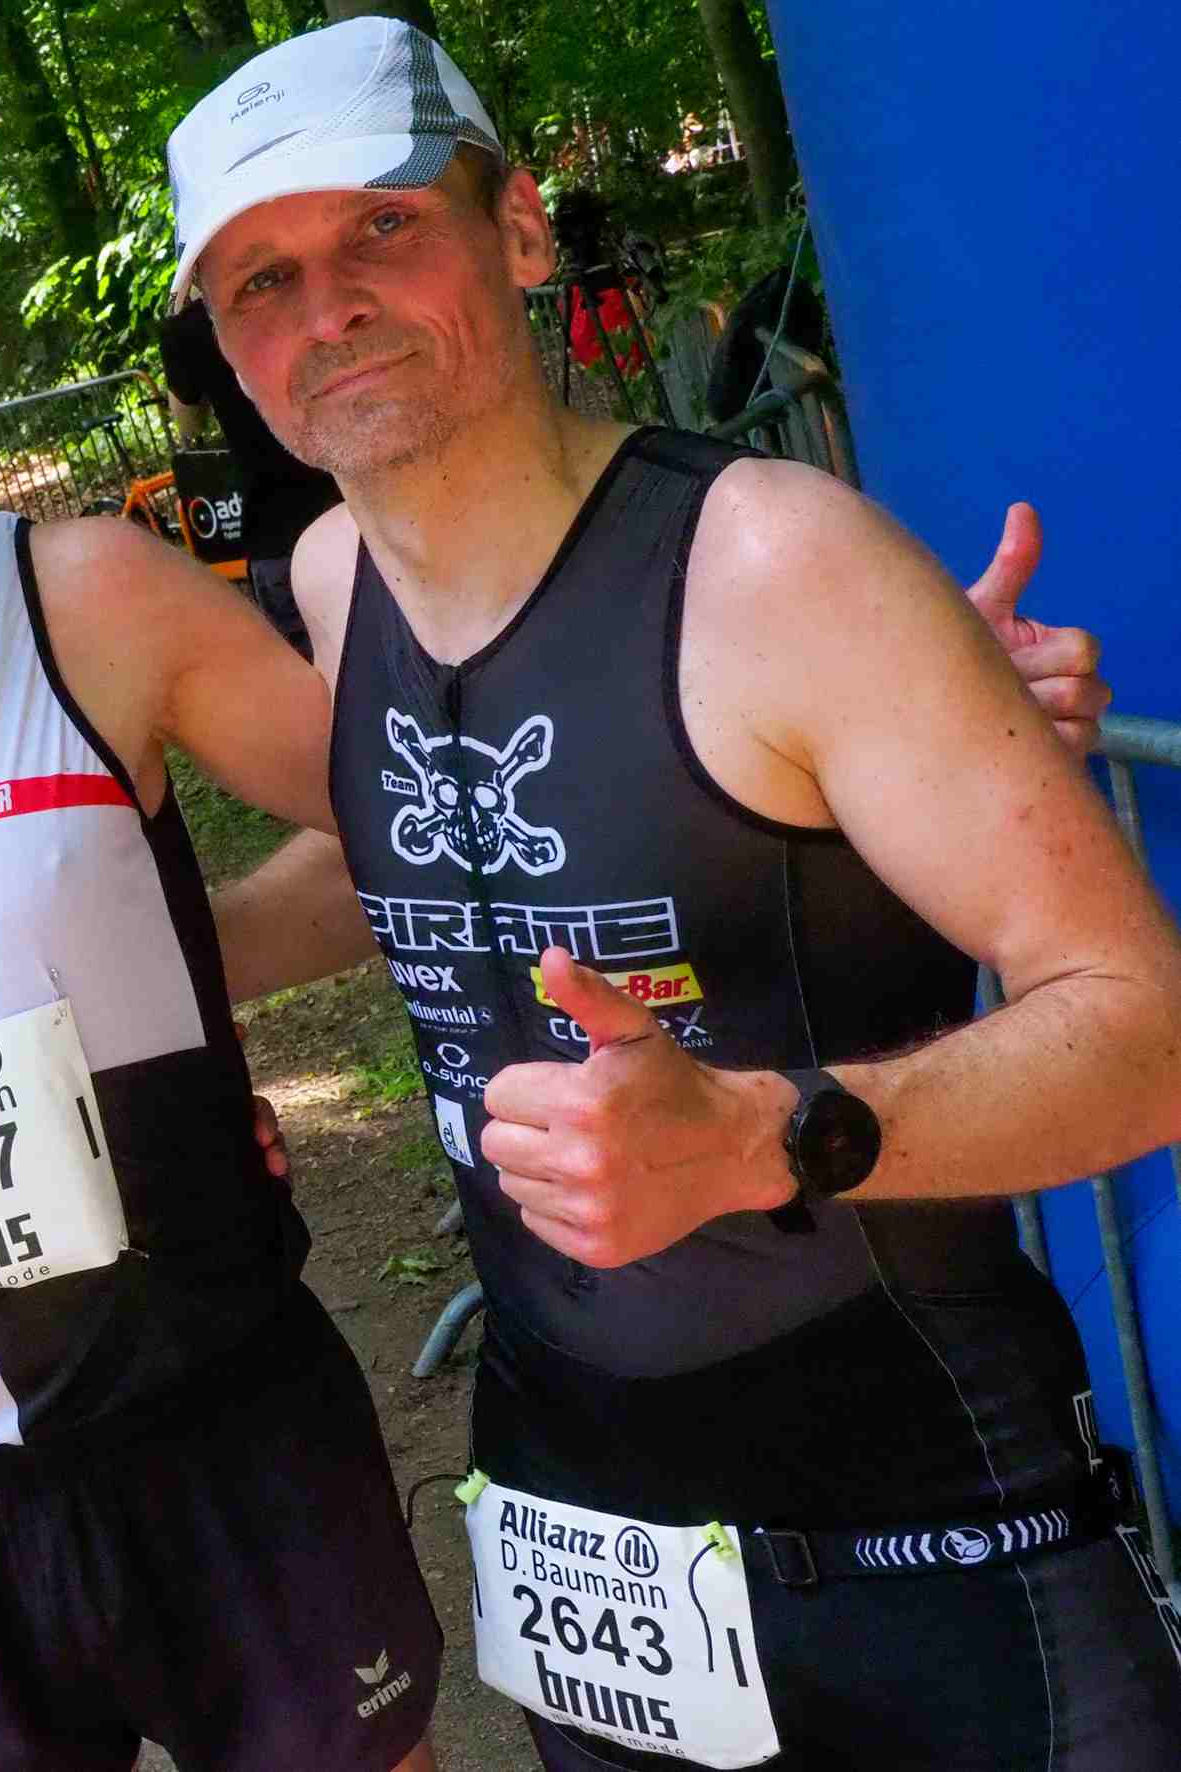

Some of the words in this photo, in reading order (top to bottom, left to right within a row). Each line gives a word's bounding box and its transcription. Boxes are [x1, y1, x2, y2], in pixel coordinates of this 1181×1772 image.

[383, 772, 417, 793] Team
[357, 889, 680, 960] PIRATE
[387, 957, 464, 992] uvex
[422, 1060, 488, 1089] o_sync
[499, 1500, 607, 1561] Allianz
[501, 1538, 527, 1576] D.
[531, 1548, 668, 1610] Baumann
[512, 1583, 674, 1677] 2643
[357, 1671, 411, 1718] erima
[534, 1650, 679, 1742] bruns
